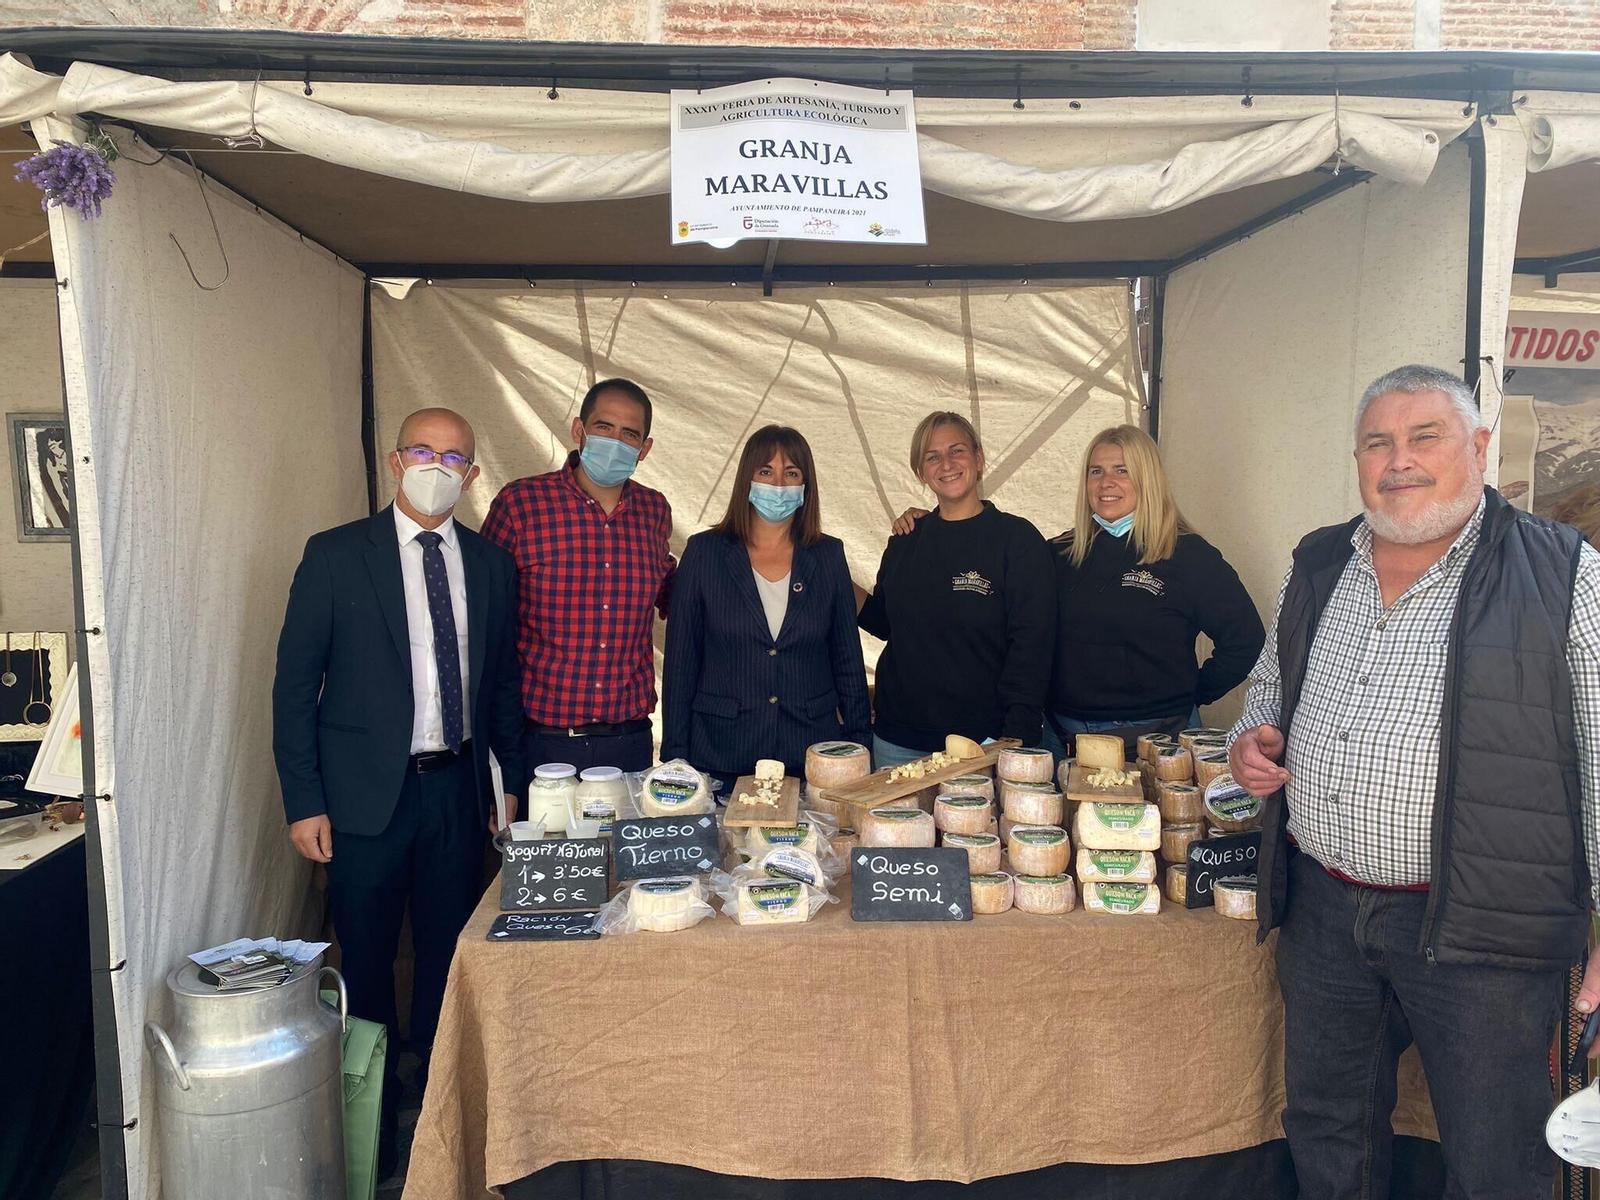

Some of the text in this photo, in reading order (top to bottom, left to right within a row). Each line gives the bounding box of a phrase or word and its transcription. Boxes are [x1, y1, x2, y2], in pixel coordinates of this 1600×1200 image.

[684, 96, 901, 115] XXXIV FERIA DE ARTESANÍA, TURISMO Y
[720, 108, 868, 126] AGRICULTURA ECOLÓGICA
[738, 139, 853, 165] GRANJA
[705, 173, 888, 200] MARAVILLAS
[730, 204, 790, 212] AYUNTAMIENTO
[803, 206, 850, 216] PAMPANEIRA
[1505, 326, 1600, 362] TIDOS
[621, 825, 695, 840] Queso
[506, 843, 605, 862] yogurt Natural
[619, 842, 703, 867] Tierno
[1201, 846, 1257, 866] QUESO
[517, 864, 529, 885] 1
[870, 856, 939, 875] Queso
[516, 887, 532, 906] 2
[871, 881, 944, 904] Semi
